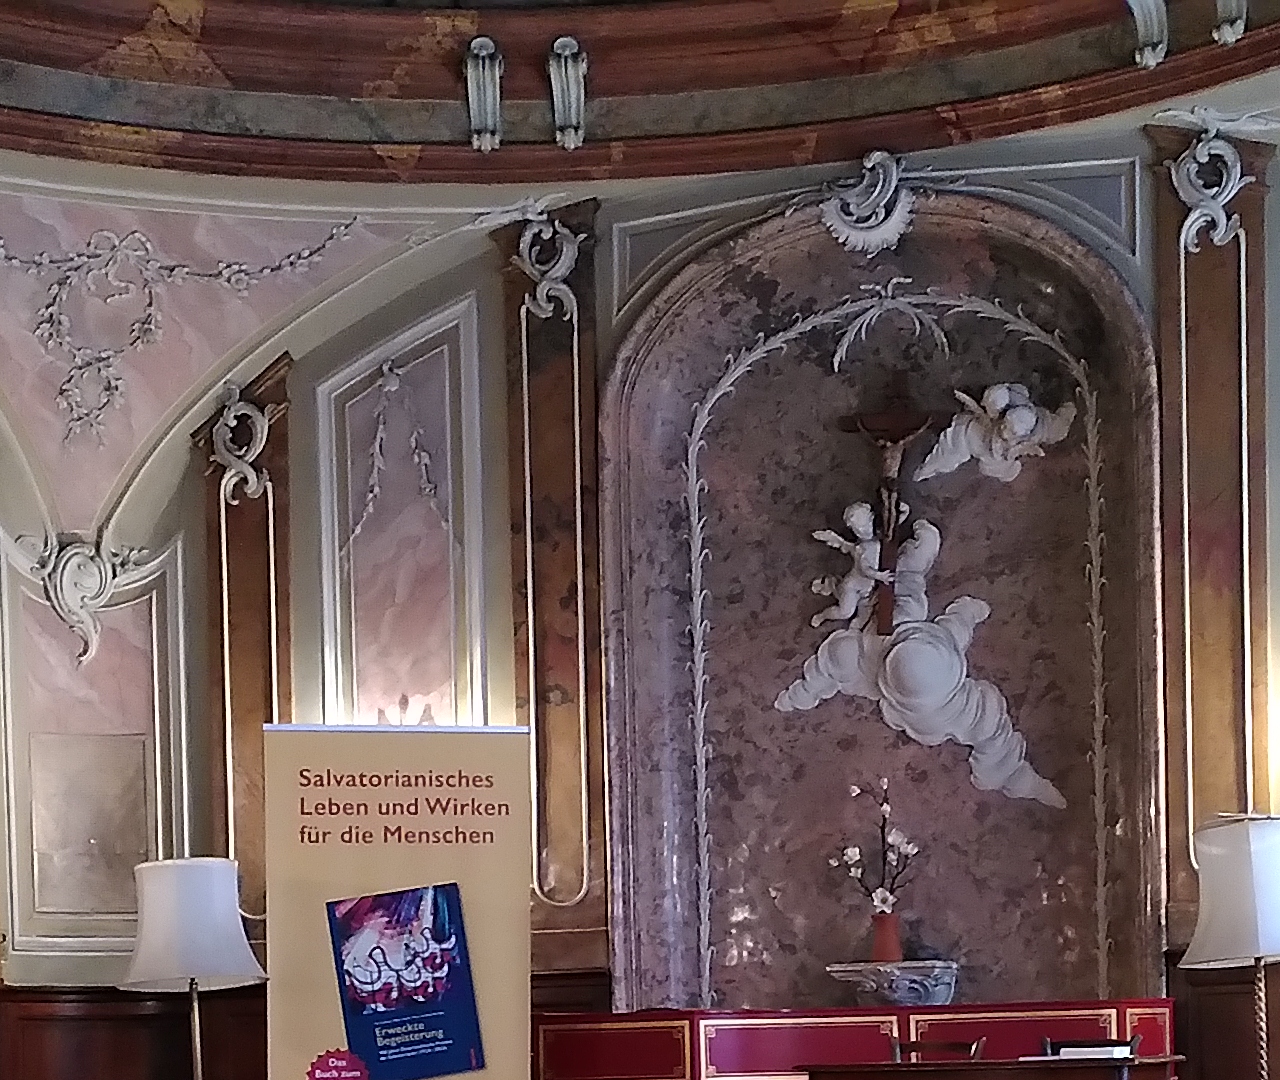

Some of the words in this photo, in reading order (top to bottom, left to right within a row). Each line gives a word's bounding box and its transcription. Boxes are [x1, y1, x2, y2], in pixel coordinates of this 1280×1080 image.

[299, 768, 494, 788] Salvatorianisches
[300, 797, 369, 816] Leben
[377, 797, 419, 816] und
[425, 797, 510, 816] Wirken
[299, 825, 332, 844] für
[340, 825, 374, 844] die
[383, 825, 494, 844] Menschen
[375, 1022, 425, 1037] Erweckte
[377, 1029, 444, 1047] Begeisterung
[328, 1058, 347, 1067] Das
[315, 1069, 339, 1078] Buch
